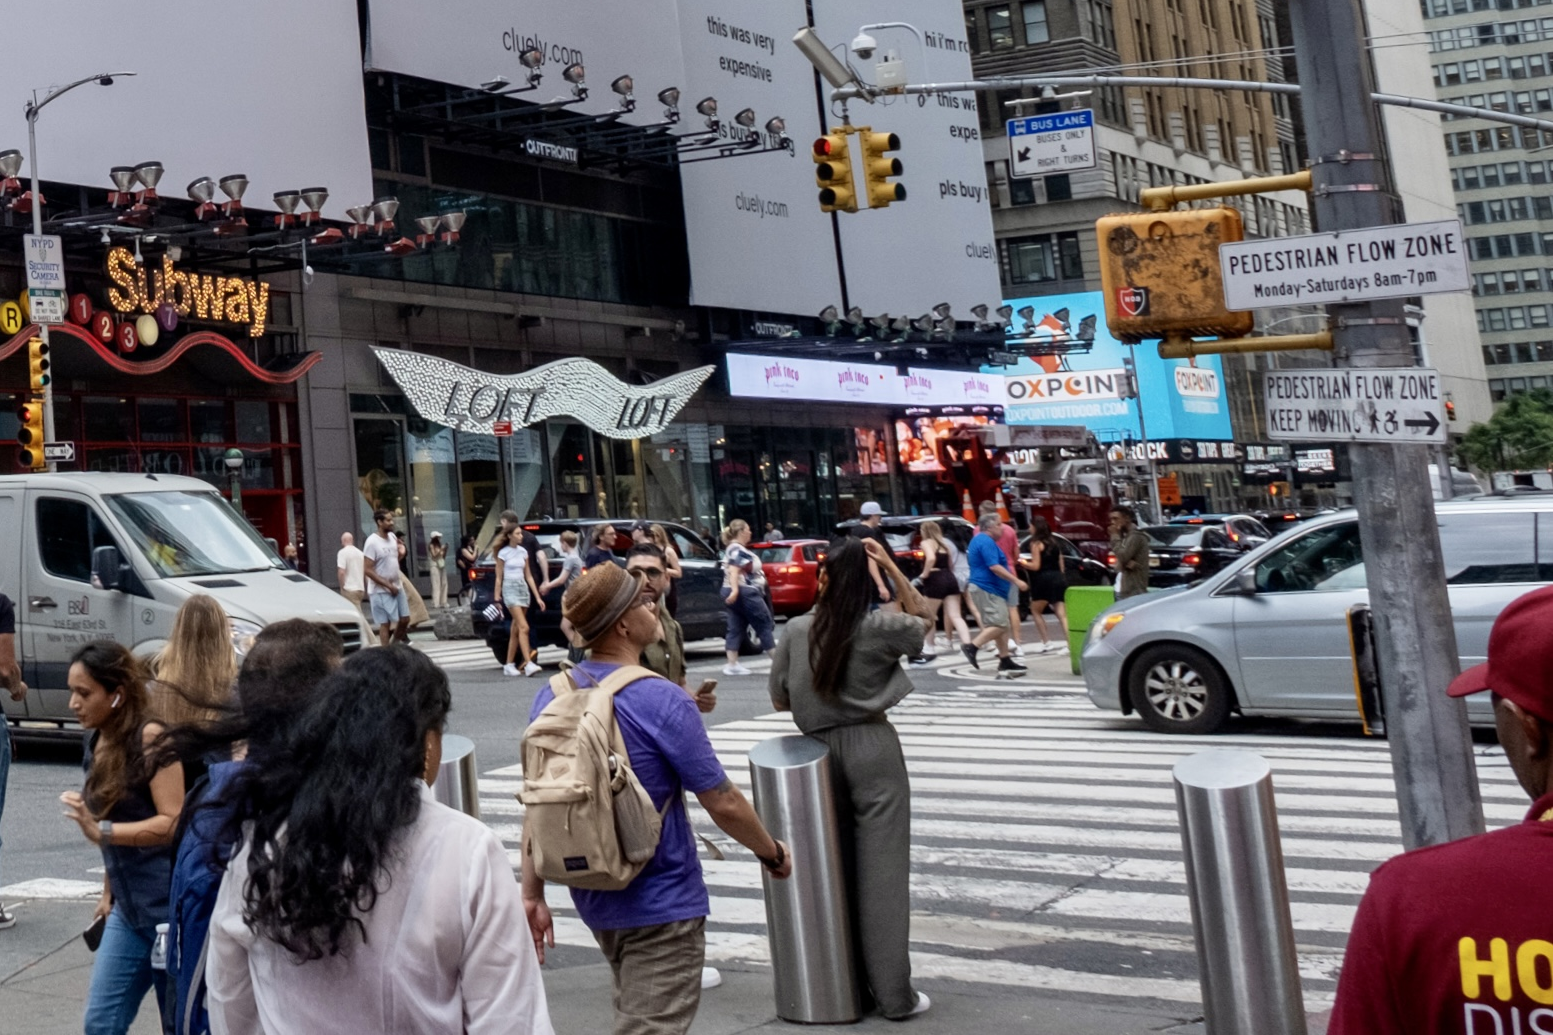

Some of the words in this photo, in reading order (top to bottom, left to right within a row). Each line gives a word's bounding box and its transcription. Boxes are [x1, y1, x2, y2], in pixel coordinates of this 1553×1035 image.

[1031, 120, 1053, 131] BUS
[1056, 115, 1087, 127] LANE
[1036, 132, 1061, 143] BUSES
[1066, 130, 1085, 140] ONLY
[1037, 157, 1059, 167] RIGHT
[1064, 154, 1089, 164] TURNS
[31, 239, 54, 249] NYPD
[1229, 245, 1339, 275] PEDESTRIAN
[1347, 239, 1396, 264] FLOW
[1404, 233, 1457, 258] ZONE
[108, 246, 270, 337] Subway
[1254, 276, 1370, 298] Monday-Saturdays
[1374, 269, 1437, 287] 8am-7pm
[1177, 371, 1216, 393] FOXPOINT
[1267, 376, 1351, 400] PEDESTRIAN
[1356, 376, 1394, 400] FLOW
[1399, 375, 1438, 400] ZONE
[446, 381, 546, 423] LOFT
[617, 396, 675, 430] LOFT
[1270, 409, 1302, 432] KEEP
